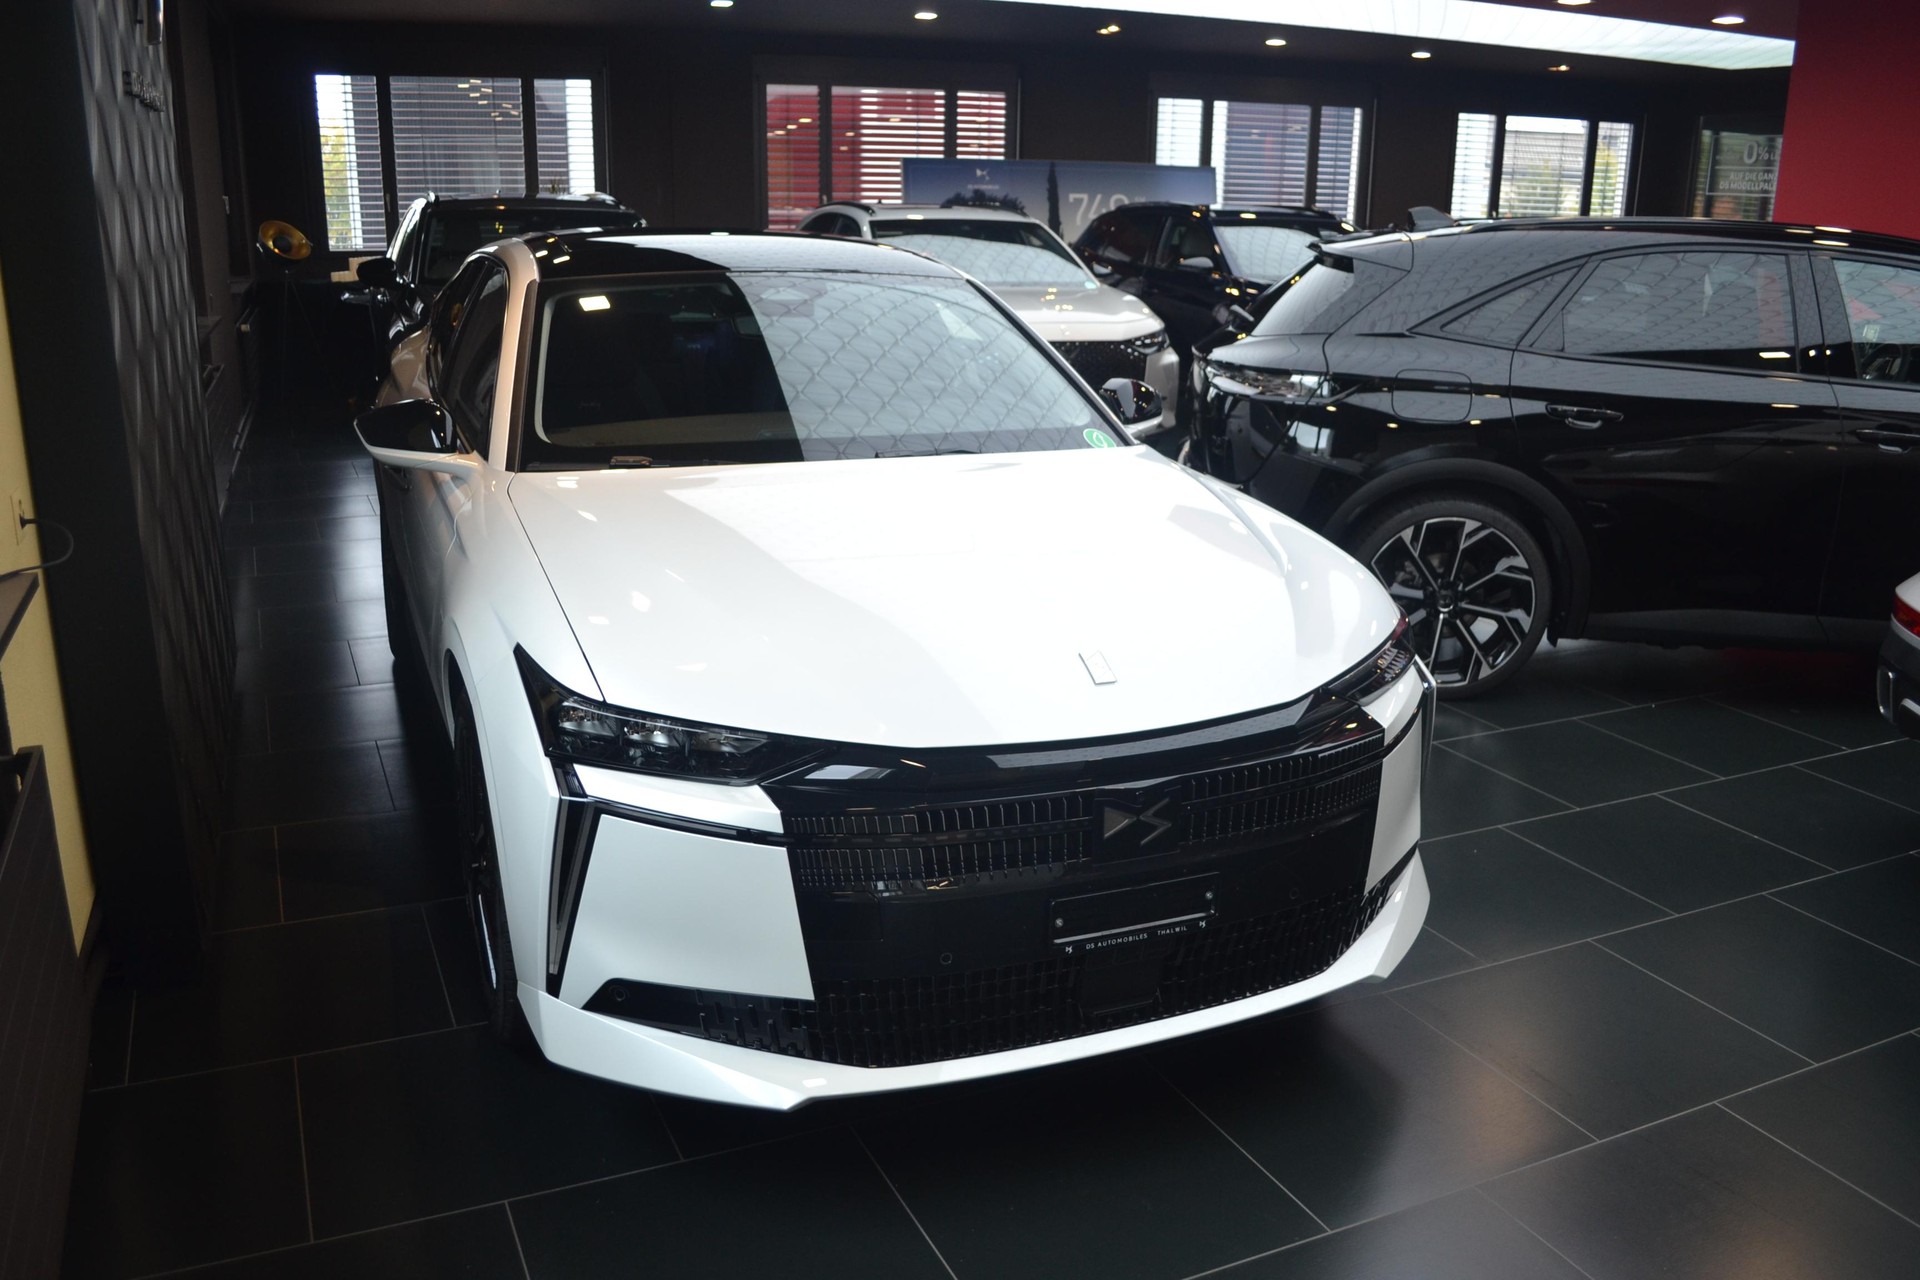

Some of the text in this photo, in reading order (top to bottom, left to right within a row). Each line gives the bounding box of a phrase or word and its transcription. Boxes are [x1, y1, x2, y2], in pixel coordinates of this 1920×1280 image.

[1743, 141, 1769, 164] 0%
[1730, 171, 1744, 181] AUF
[1745, 171, 1758, 181] DIE
[1097, 933, 1148, 948] AUTOMOBILES
[1157, 925, 1188, 936] THALWIL
